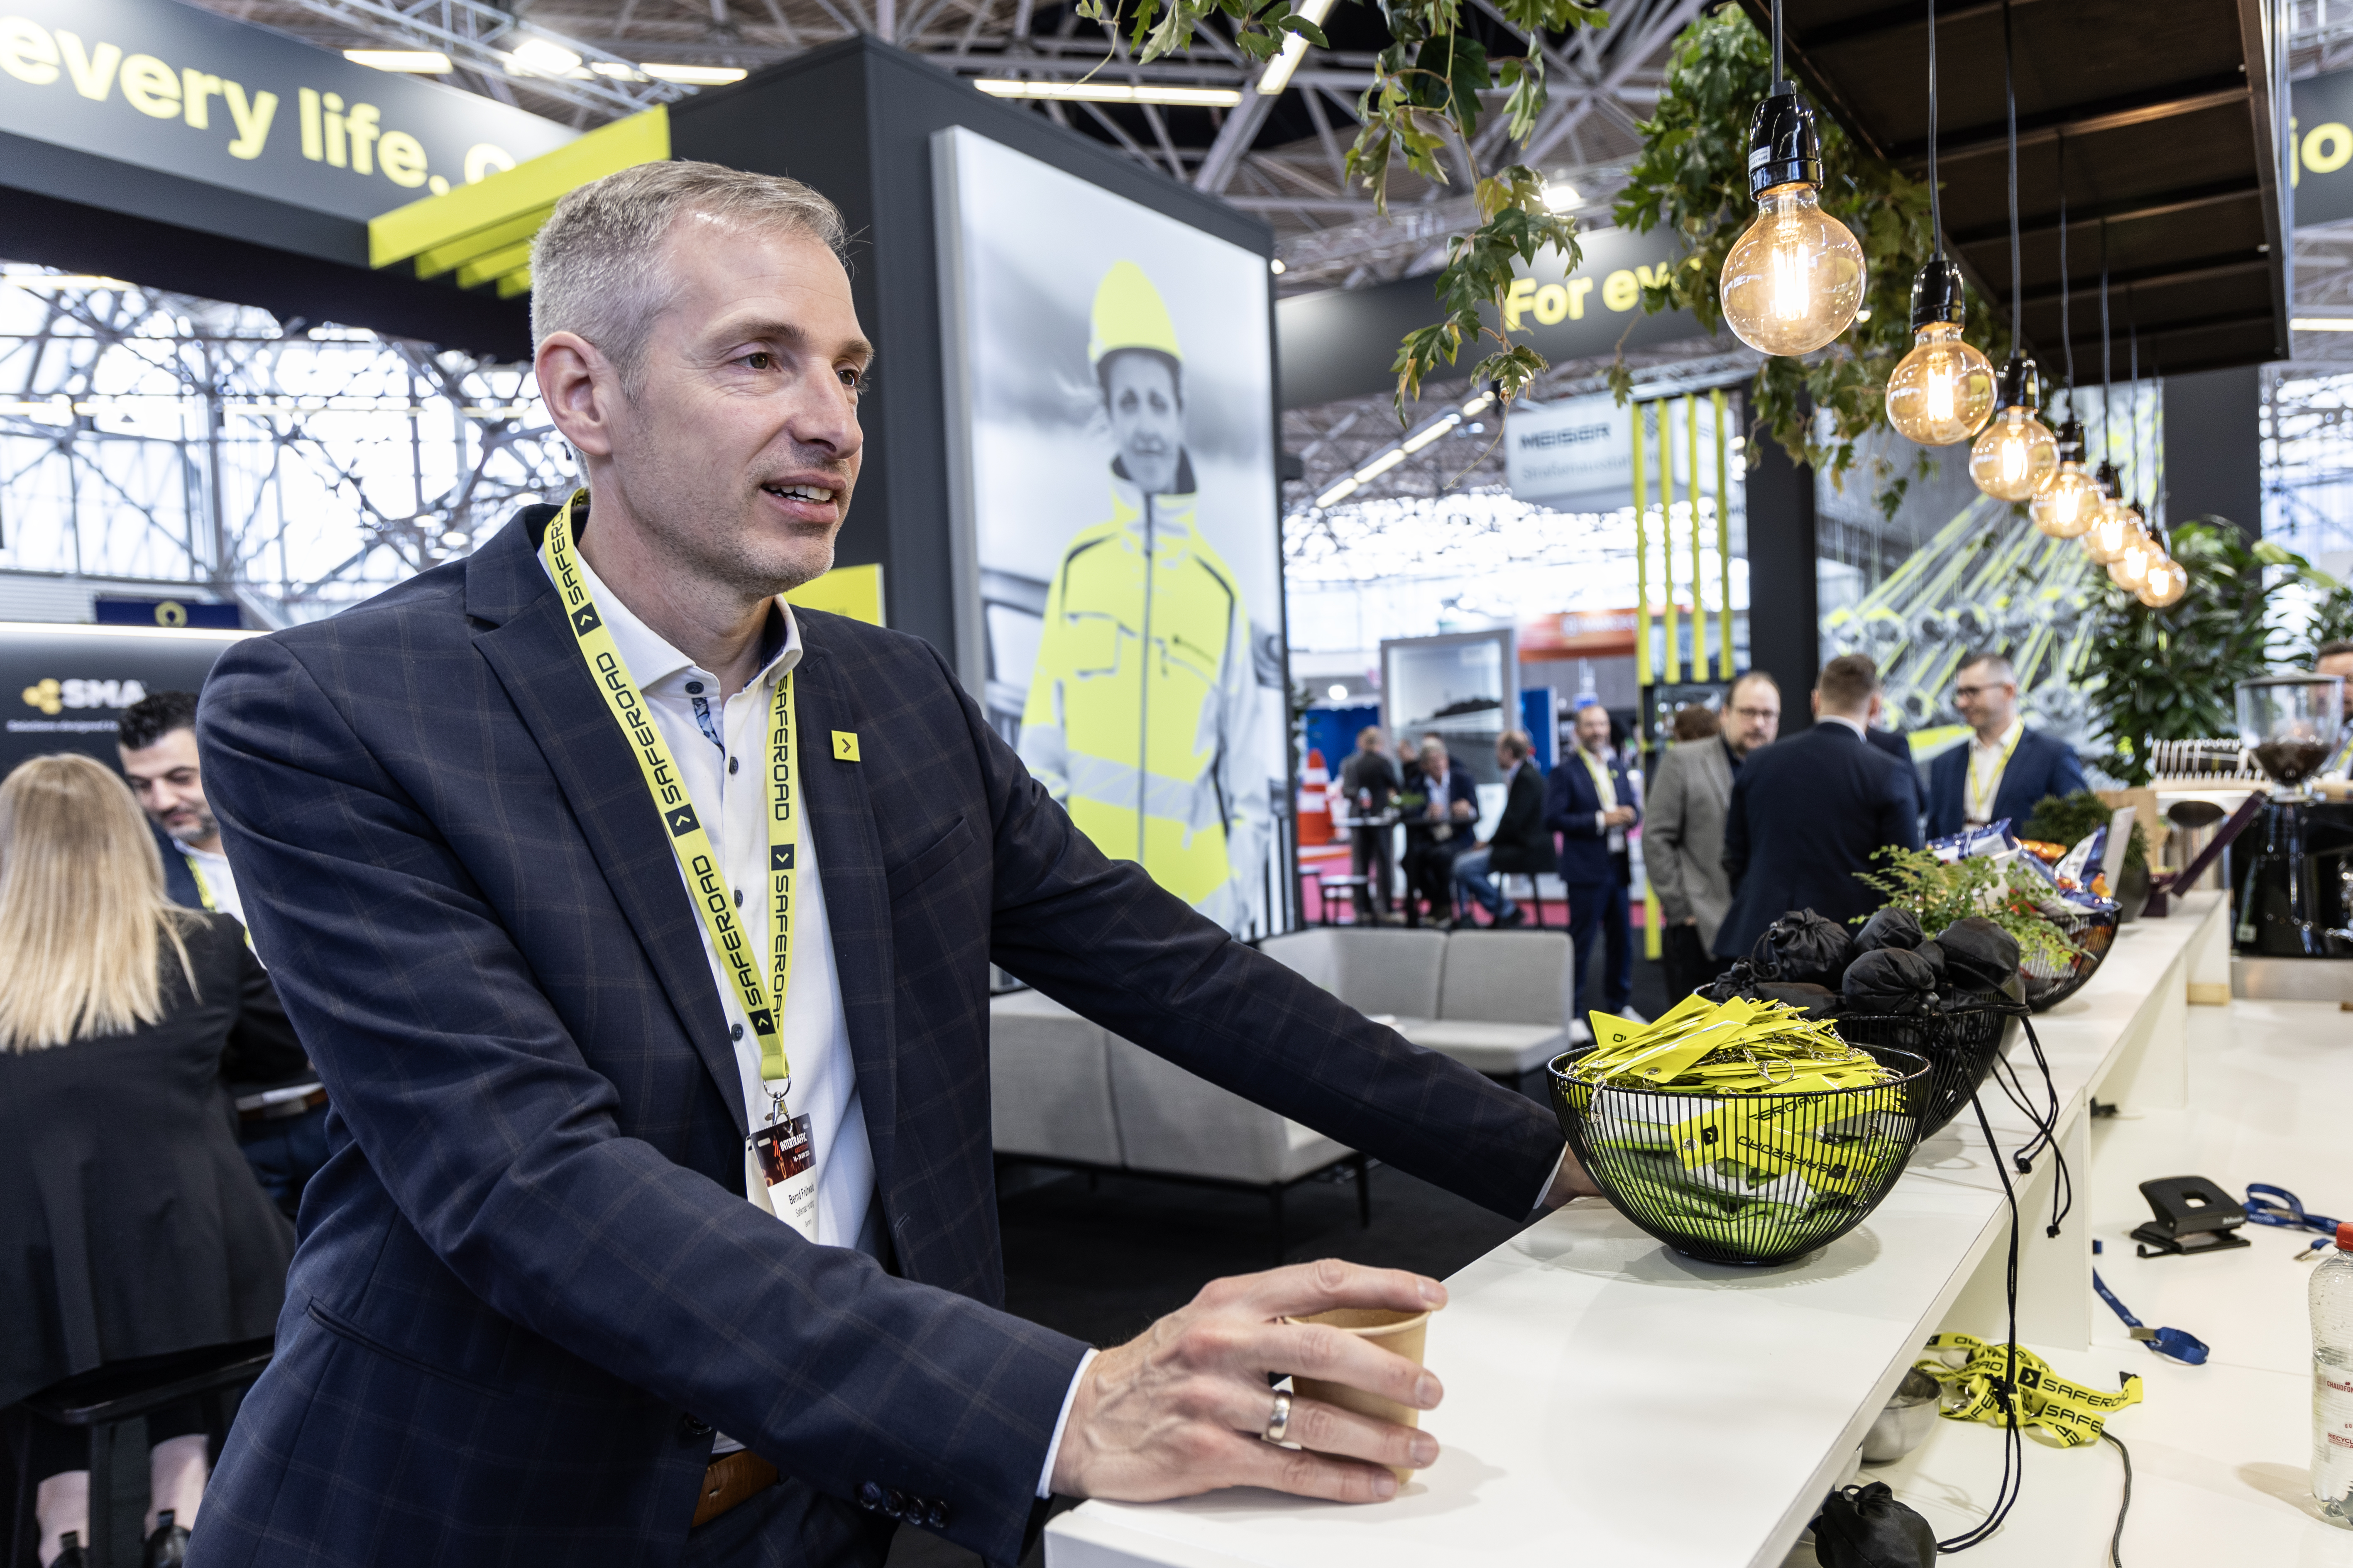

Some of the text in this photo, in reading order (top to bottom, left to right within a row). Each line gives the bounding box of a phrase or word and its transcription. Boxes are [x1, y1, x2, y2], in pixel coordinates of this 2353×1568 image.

[0, 15, 450, 197] every life.
[1504, 257, 1701, 331] For ev
[551, 510, 585, 605] SAFERO
[597, 652, 682, 804] SAFEROAD
[773, 675, 789, 821] SAFEROAD
[692, 855, 763, 1006] SAFEROAD
[780, 1132, 807, 1152] INTERTRAFFIC
[1737, 1136, 1829, 1172] SAFEROAD
[788, 1189, 801, 1204] Bernd
[2042, 1379, 2129, 1407] SAFEROAD
